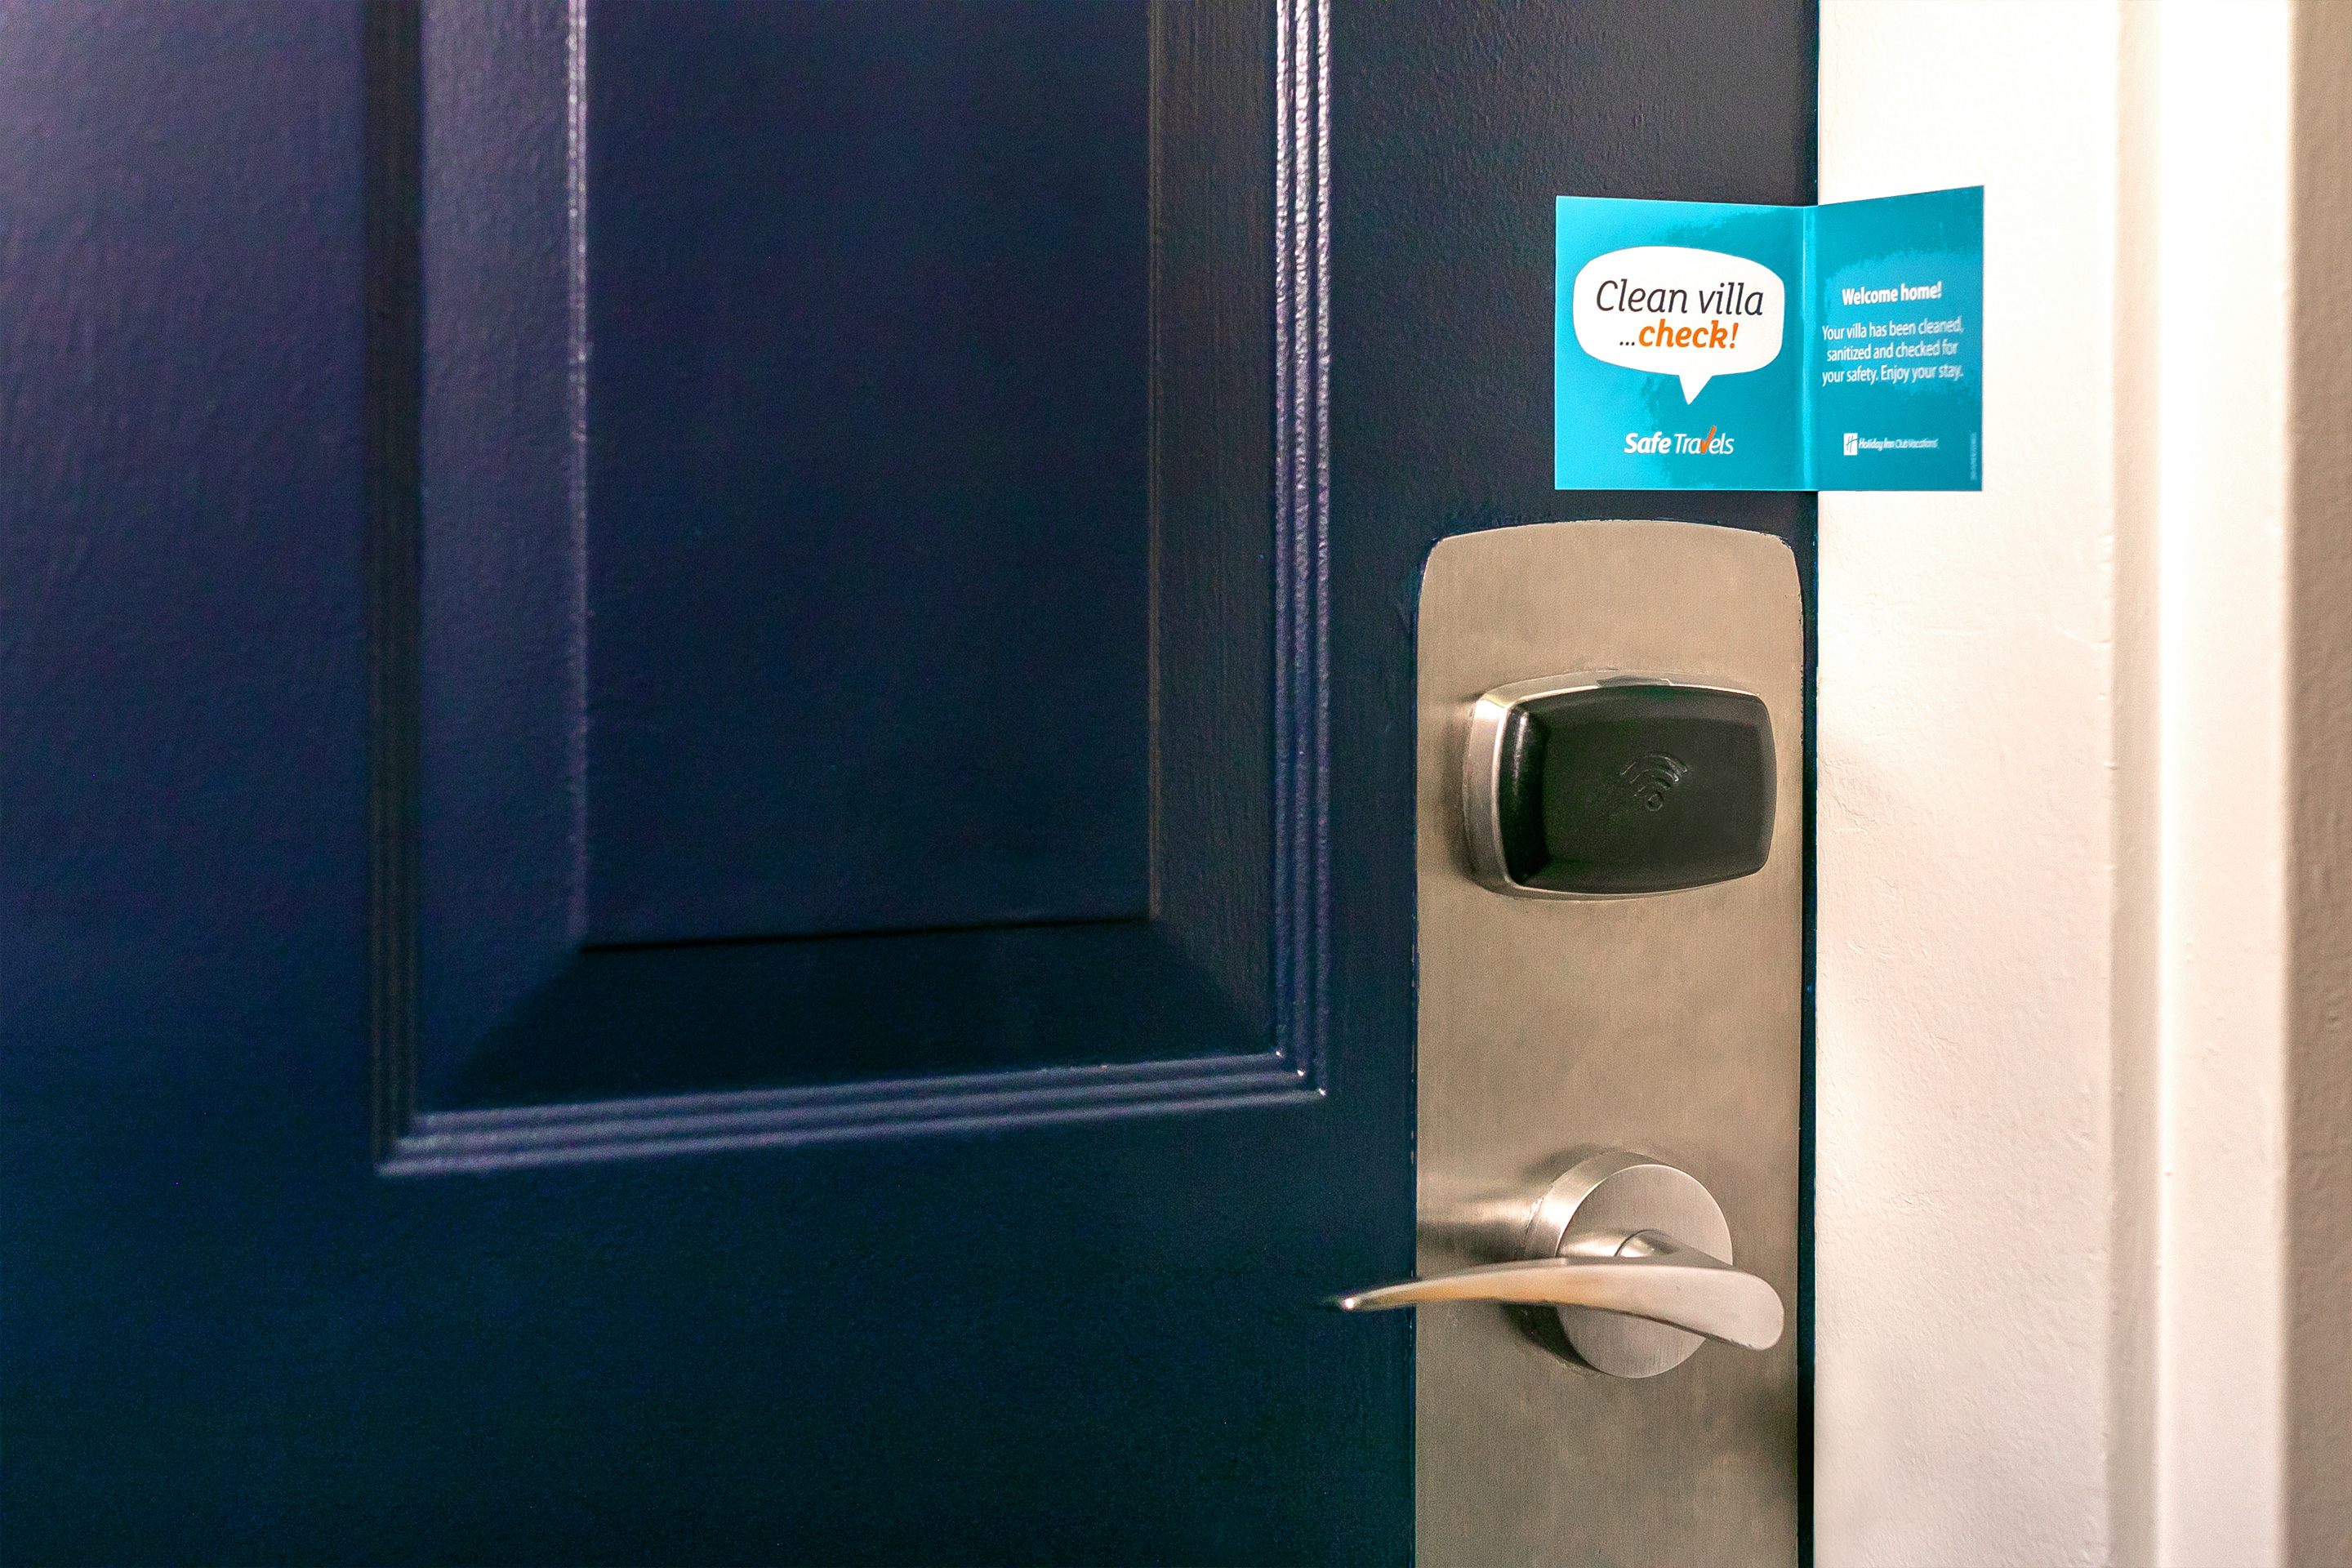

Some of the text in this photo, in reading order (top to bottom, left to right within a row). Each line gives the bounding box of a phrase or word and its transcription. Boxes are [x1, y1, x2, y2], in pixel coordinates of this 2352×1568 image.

[1596, 278, 1764, 316] Clean villa
[1842, 280, 1943, 306] Welcome home!
[1822, 315, 1964, 341] Your villa has been cleaned,
[1827, 338, 1959, 362] sanitized and checked for
[1822, 363, 1964, 387] your safety. Enjoy your stay.
[1623, 425, 1735, 454] Safe Travels
[1858, 438, 1883, 452] Holiday
[1883, 437, 1895, 449] Inn
